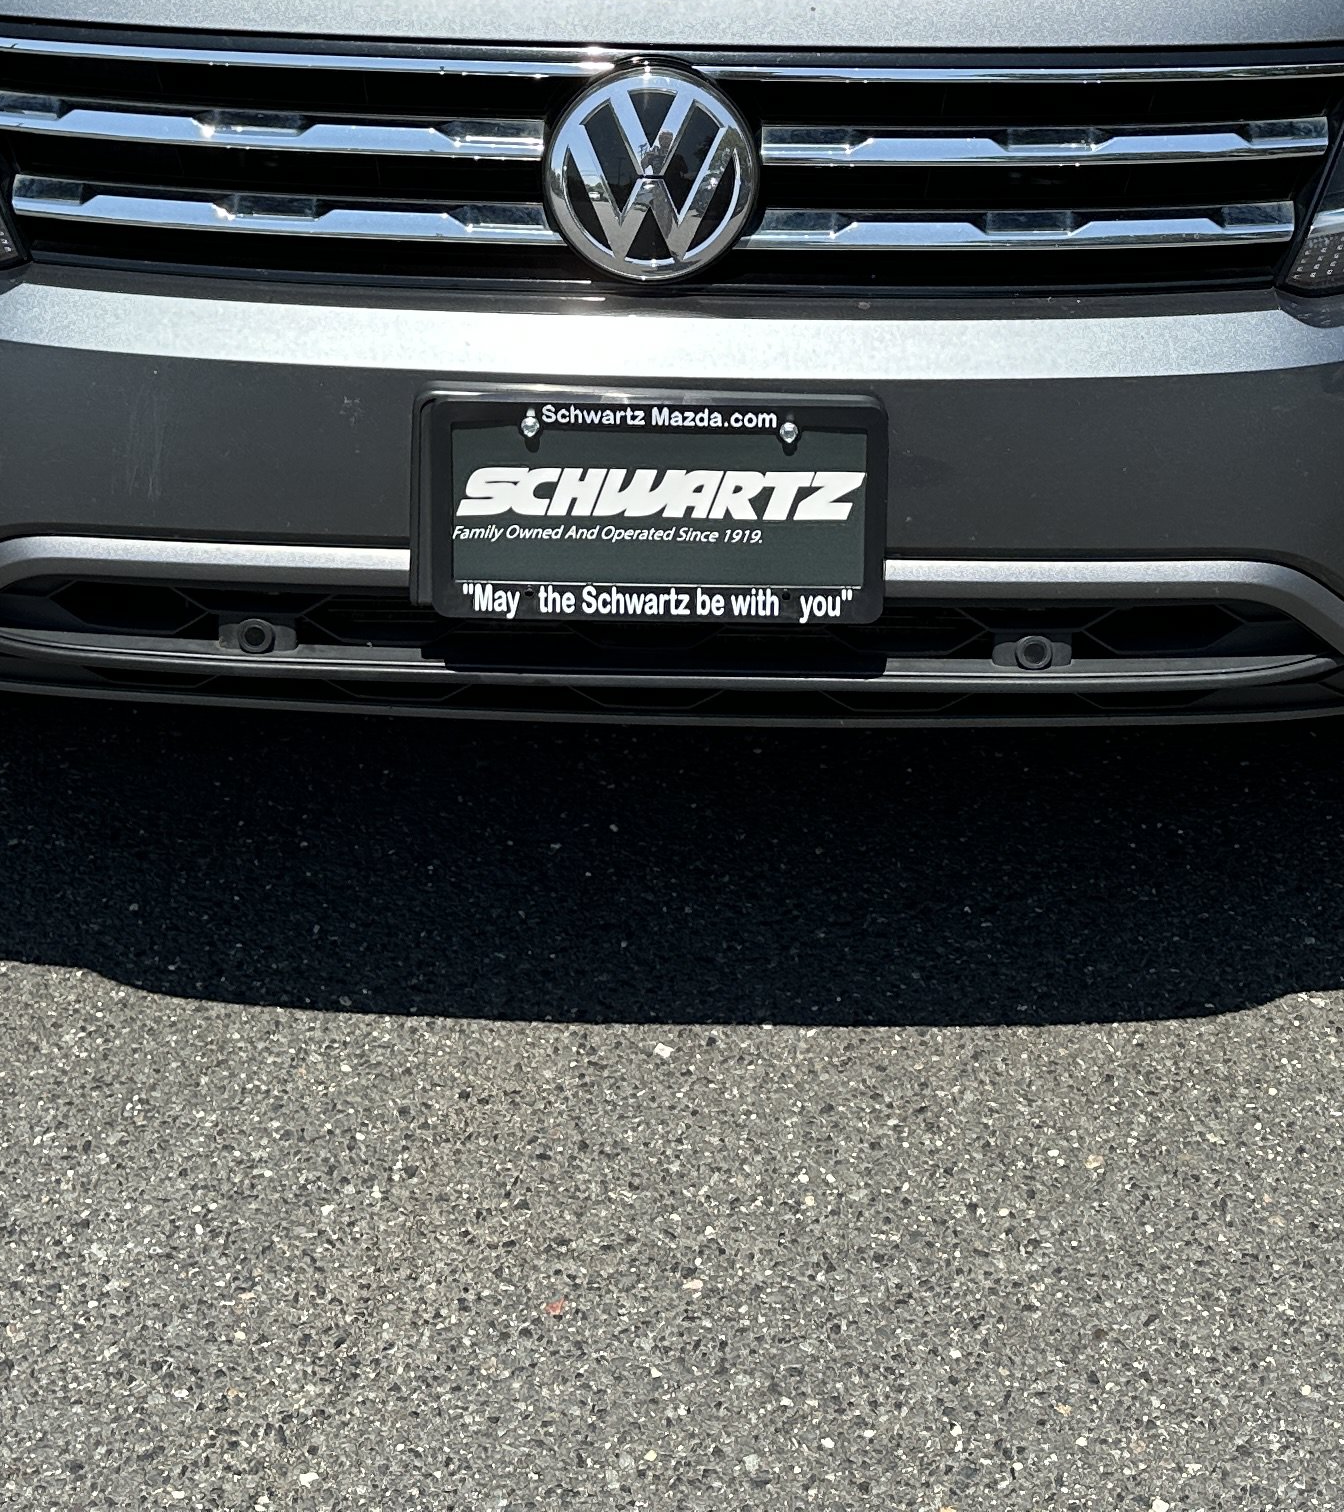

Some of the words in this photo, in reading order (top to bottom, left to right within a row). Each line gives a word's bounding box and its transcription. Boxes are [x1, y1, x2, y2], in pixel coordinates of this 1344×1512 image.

[541, 404, 646, 426] Schwartz
[651, 406, 777, 428] Mazda.com
[456, 466, 867, 521] SCHWARTZ
[452, 524, 504, 543] Family
[506, 524, 564, 539] Owned
[565, 525, 601, 539] And
[601, 526, 676, 543] Operated
[677, 527, 719, 542] Since
[723, 529, 764, 544] 1919.
[462, 583, 520, 620] "May
[538, 584, 575, 613] the
[582, 585, 690, 615] Schwartz
[696, 587, 725, 616] be
[730, 588, 780, 617] with
[799, 589, 853, 624] you"
